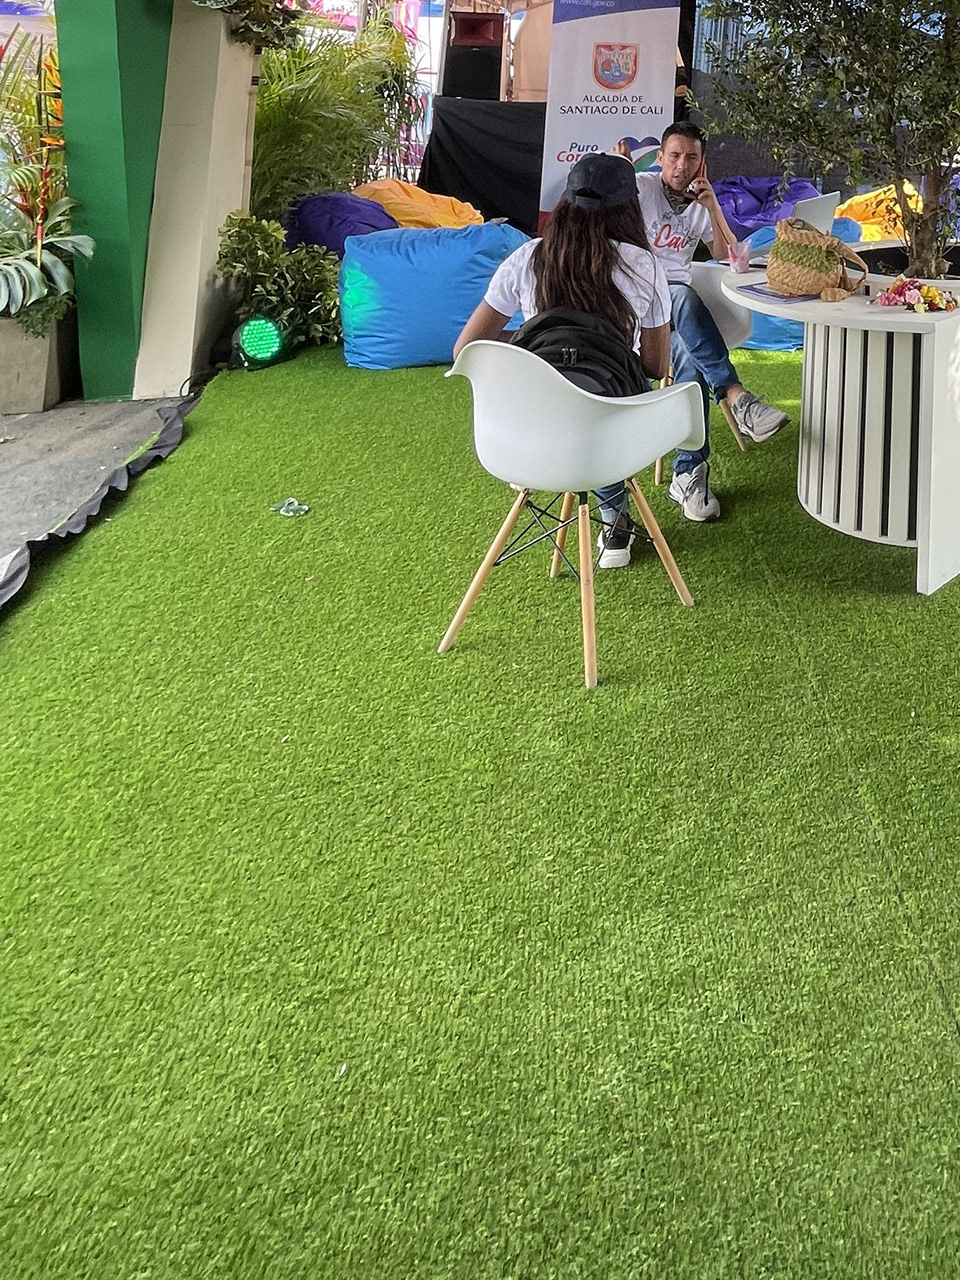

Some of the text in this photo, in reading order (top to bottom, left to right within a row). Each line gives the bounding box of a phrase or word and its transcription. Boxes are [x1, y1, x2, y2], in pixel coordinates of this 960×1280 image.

[582, 93, 644, 103] ALCALDÍA DE
[559, 105, 664, 115] SANTIAGO DE CALI
[569, 142, 599, 152] Puro
